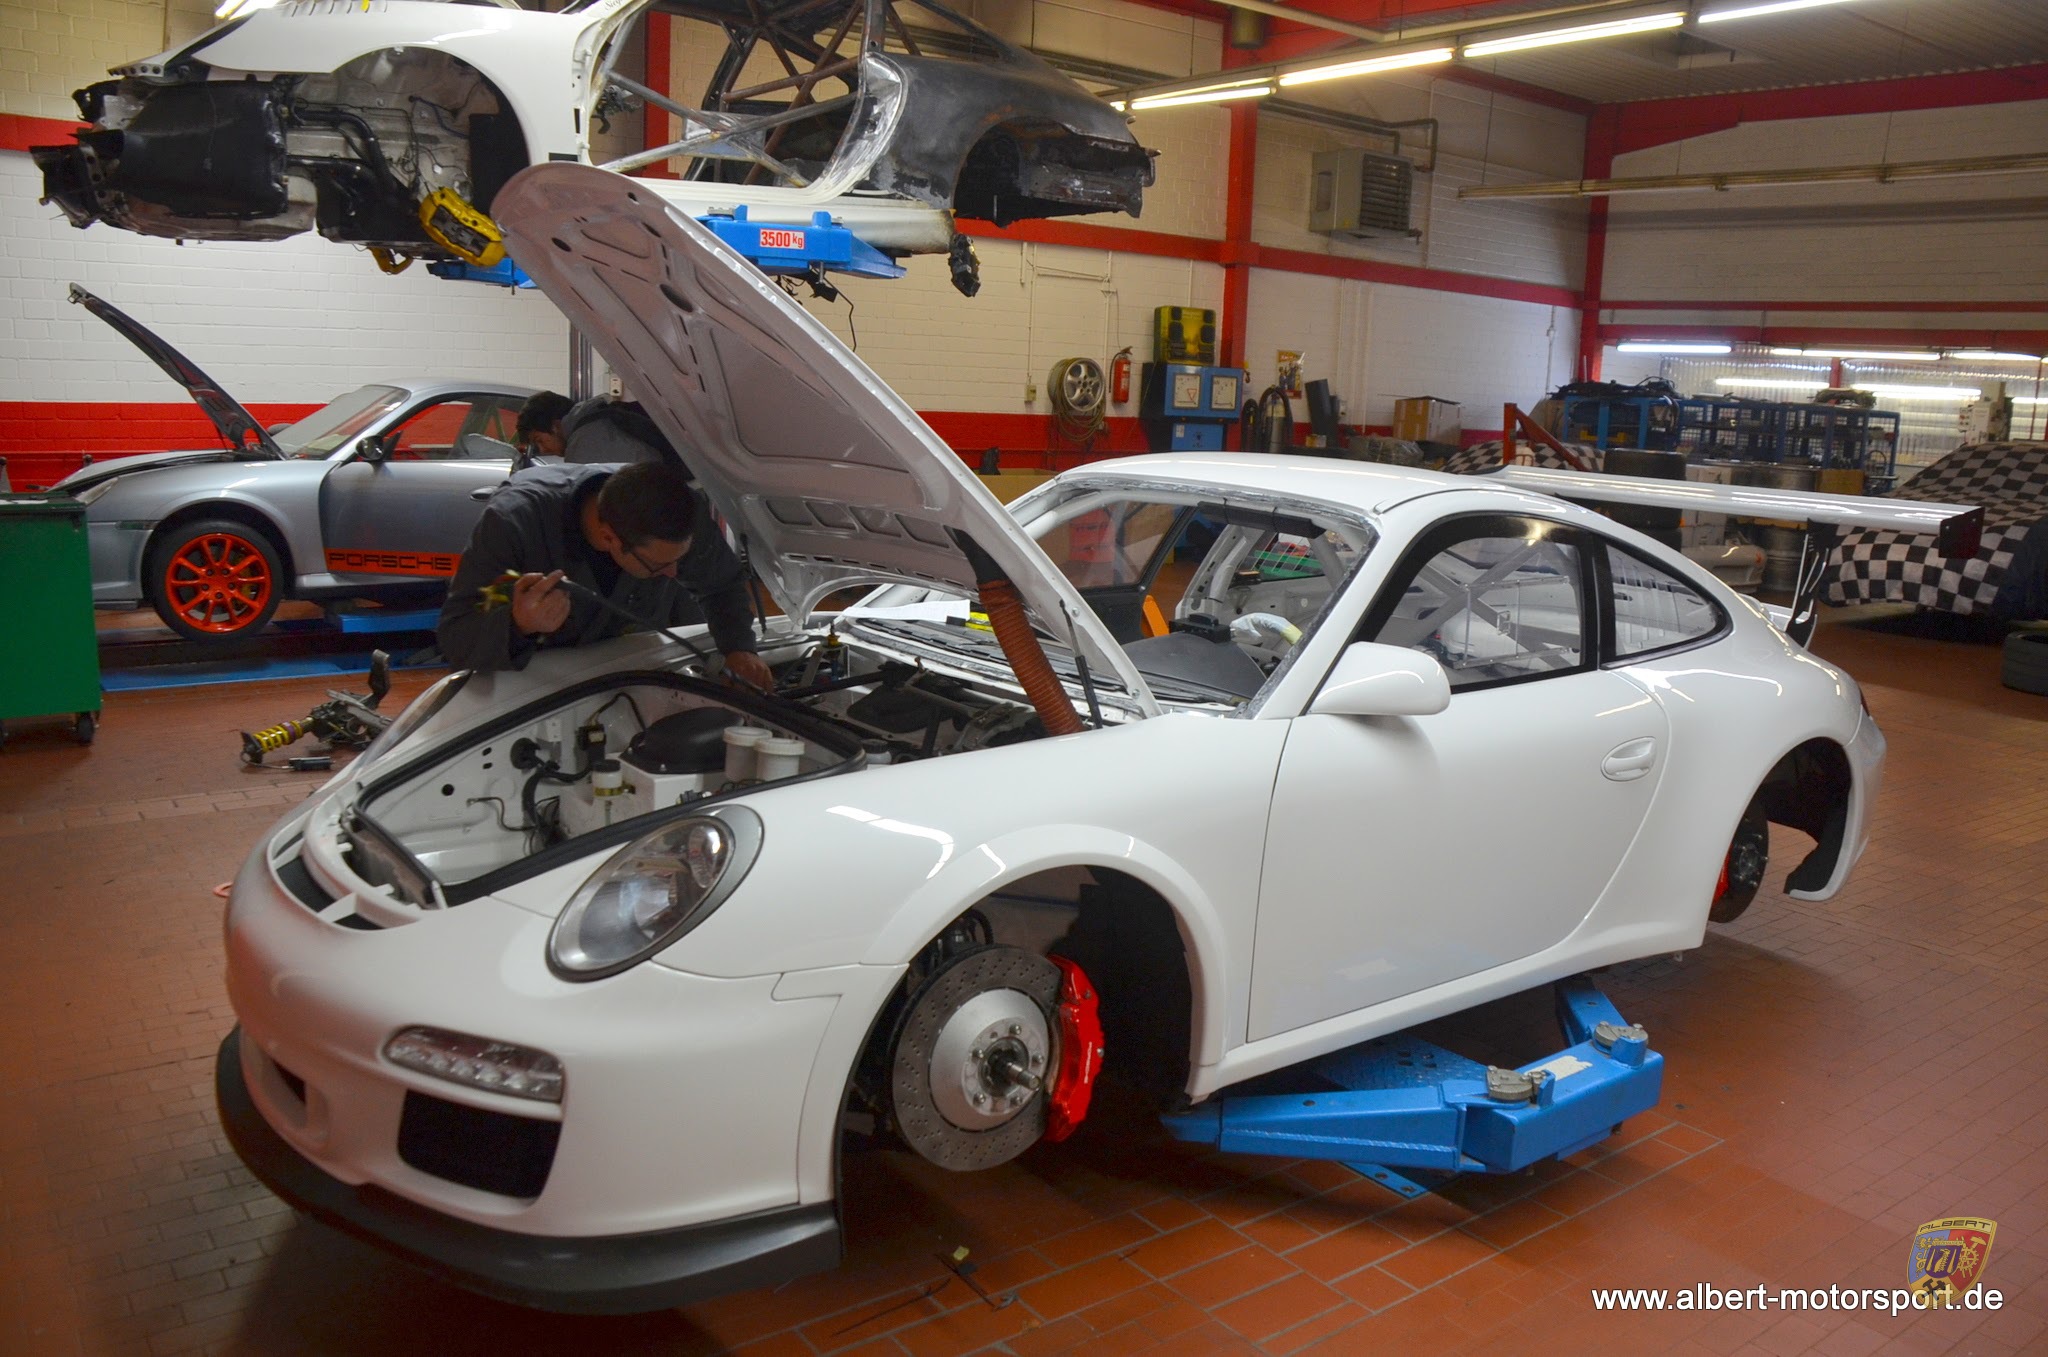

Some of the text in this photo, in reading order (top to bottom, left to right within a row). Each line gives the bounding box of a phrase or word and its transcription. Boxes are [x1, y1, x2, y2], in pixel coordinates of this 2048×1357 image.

[761, 231, 803, 248] 3500 kg
[329, 552, 452, 571] PORSCHE
